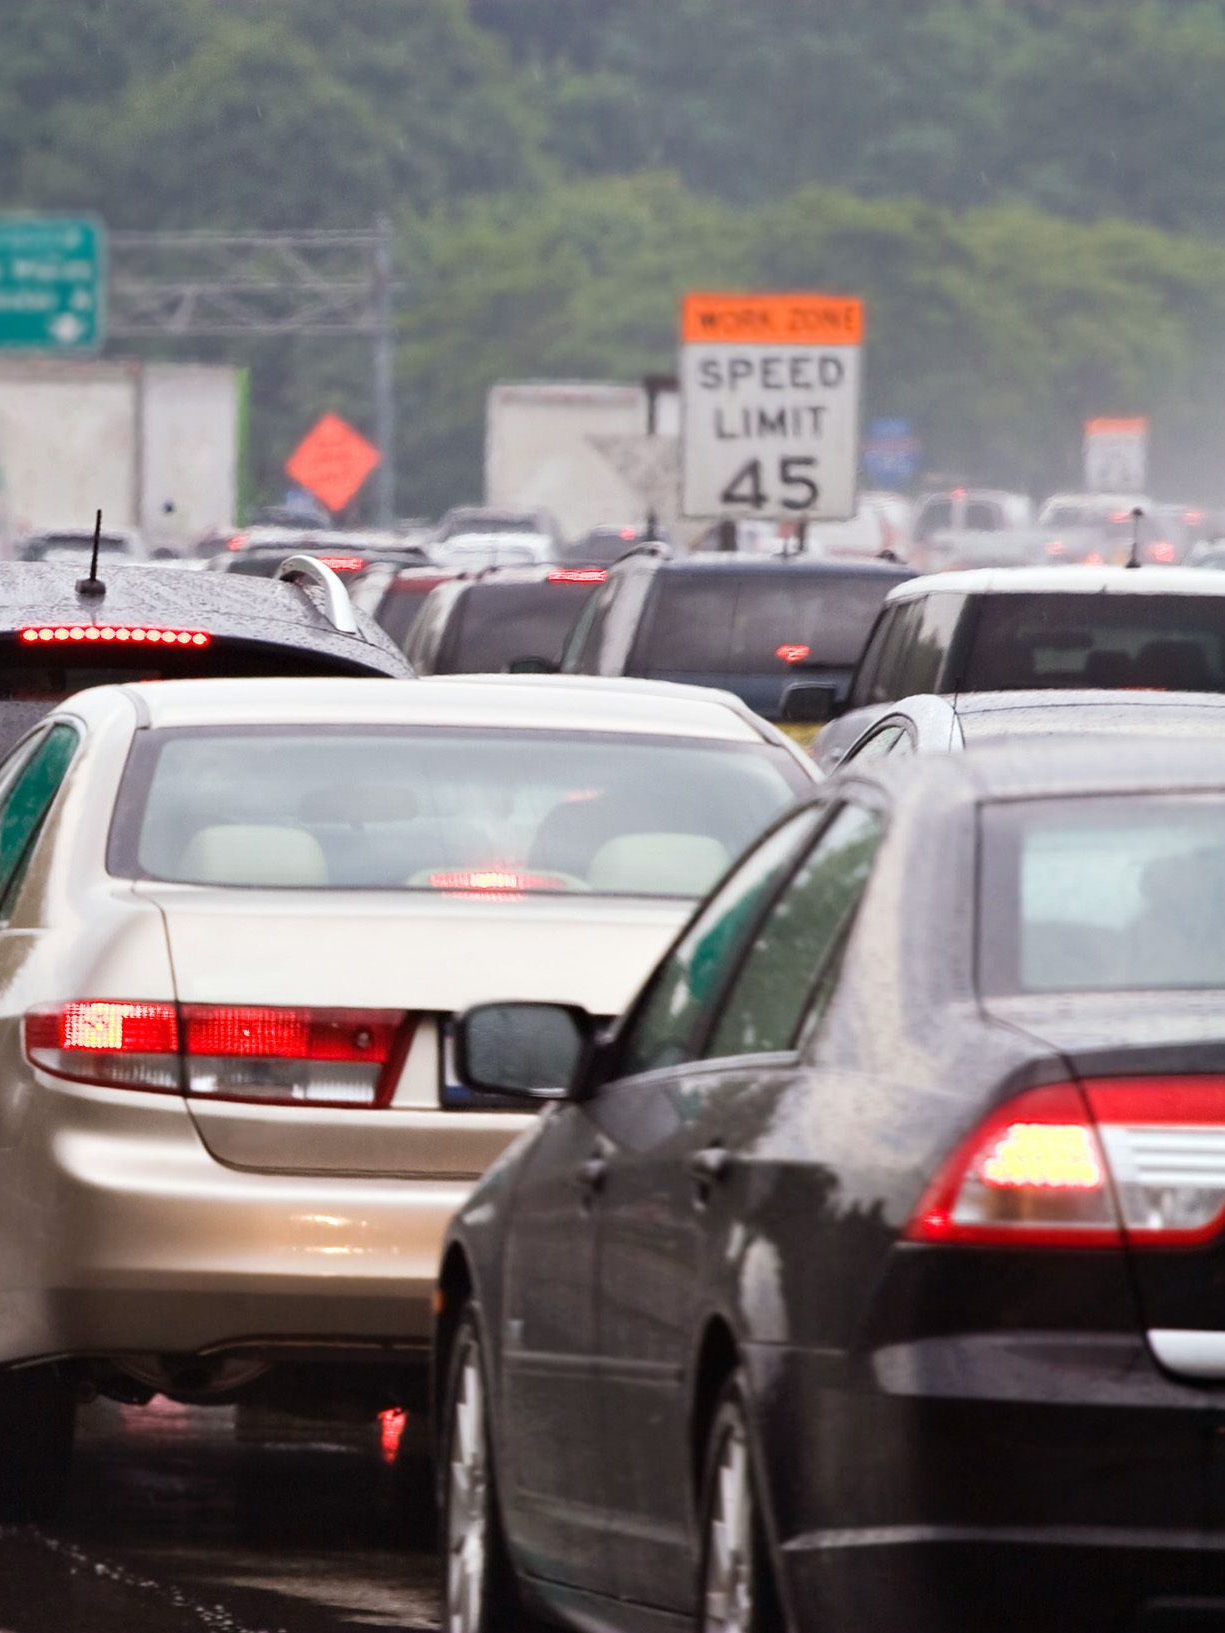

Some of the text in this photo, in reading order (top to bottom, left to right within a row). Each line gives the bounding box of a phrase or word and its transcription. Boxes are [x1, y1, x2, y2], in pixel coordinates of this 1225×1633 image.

[698, 306, 856, 334] WORK ZONE
[699, 355, 845, 391] SPEED
[714, 405, 827, 439] LIMIT
[721, 456, 819, 511] 45
